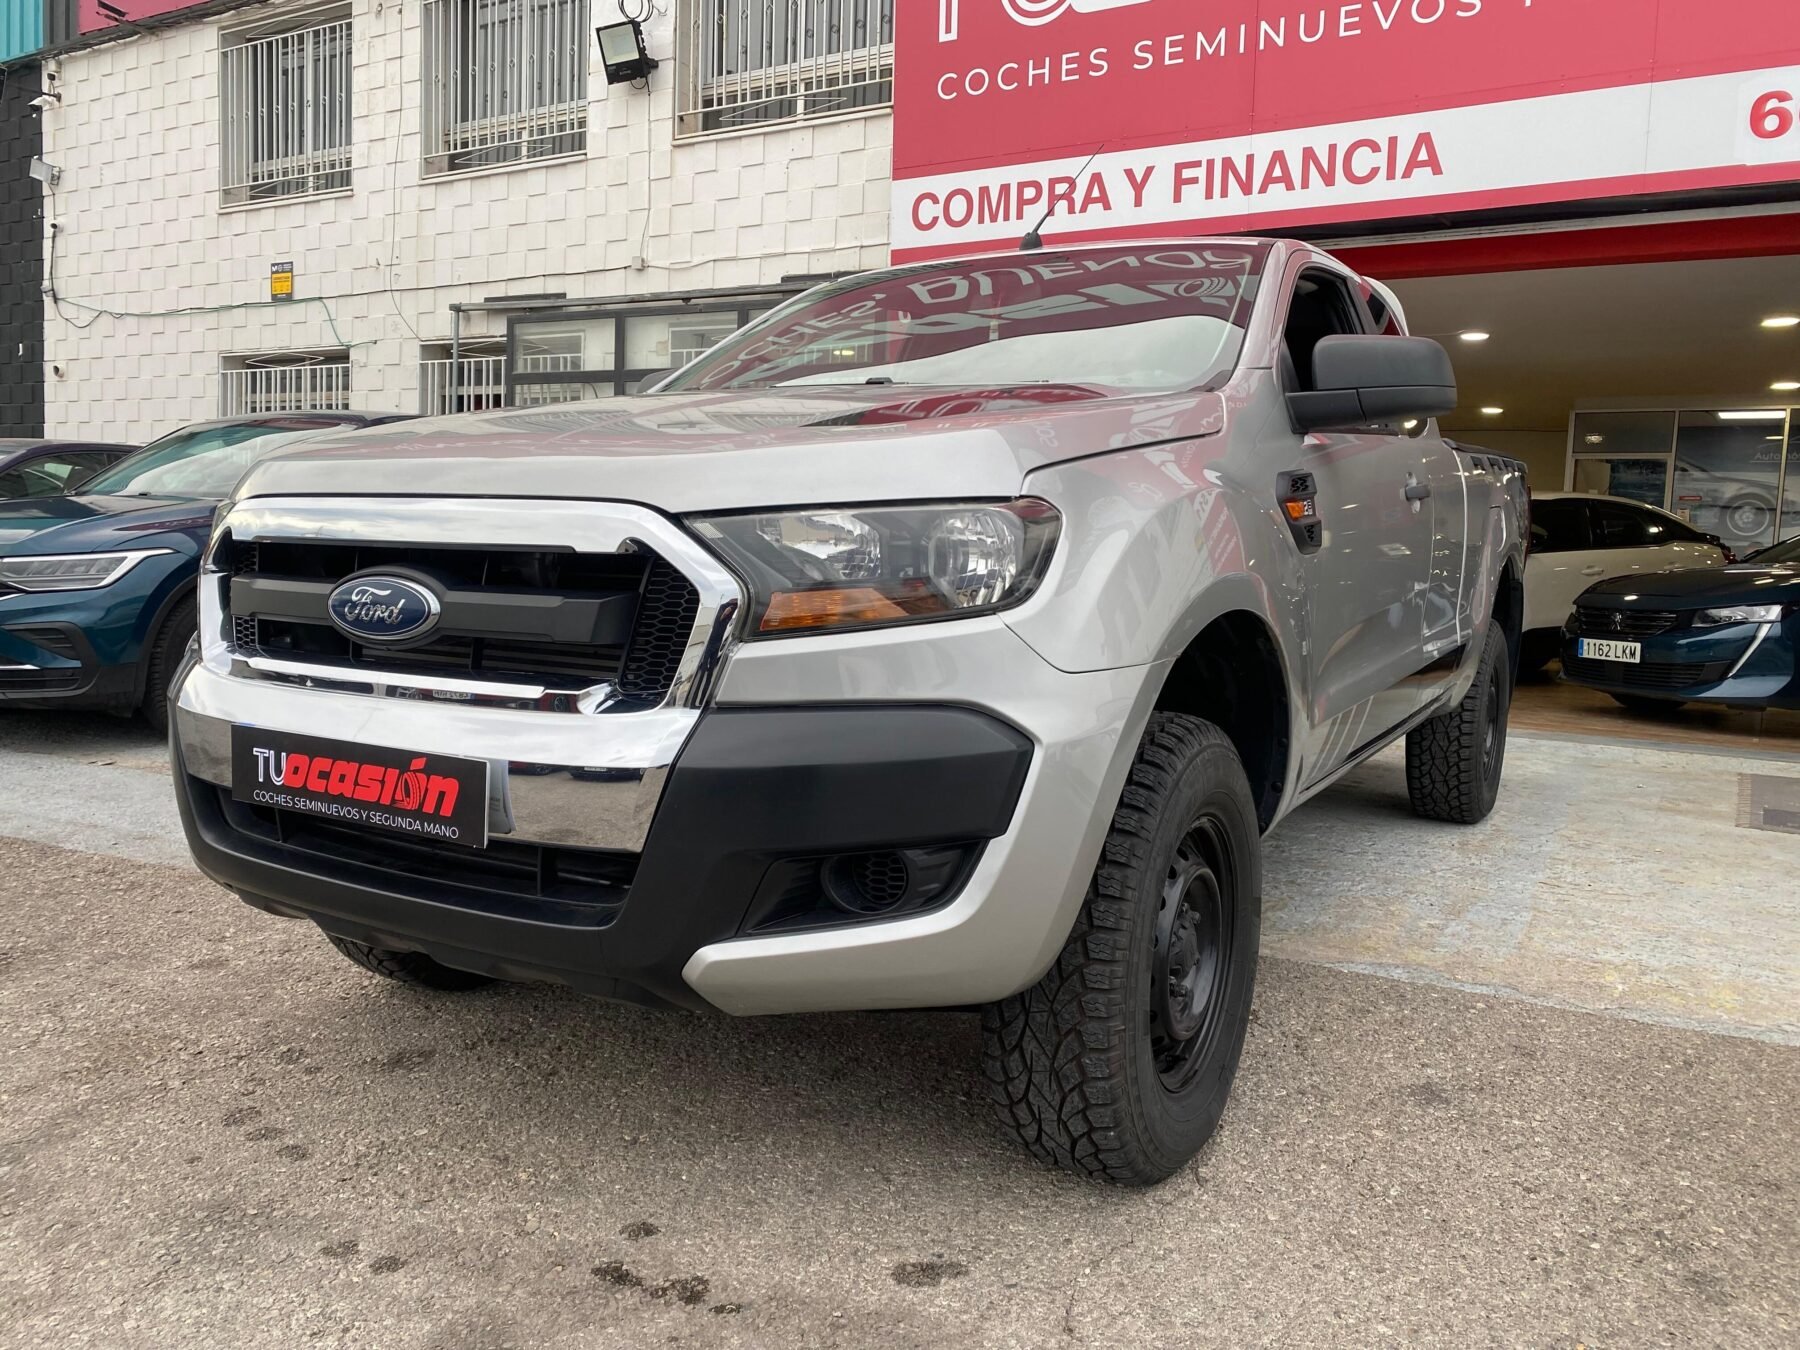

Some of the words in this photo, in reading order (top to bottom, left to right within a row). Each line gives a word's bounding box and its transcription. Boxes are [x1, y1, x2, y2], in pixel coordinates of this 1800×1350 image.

[937, 47, 1109, 100] COCHES
[1133, 0, 1482, 70] SEMINUEVOS
[1750, 89, 1800, 139] 6
[911, 171, 1112, 232] COMPRA
[1123, 164, 1156, 208] Y
[1173, 131, 1444, 203] FINANCIA
[344, 586, 406, 625] Ford
[1587, 641, 1612, 658] 1162
[1614, 644, 1637, 660] LKM
[253, 789, 293, 807] COCHES
[294, 797, 360, 820] SEMINUEVOS
[360, 809, 369, 821] Y
[369, 811, 422, 832] SEGUNDA
[424, 821, 459, 839] MANO
